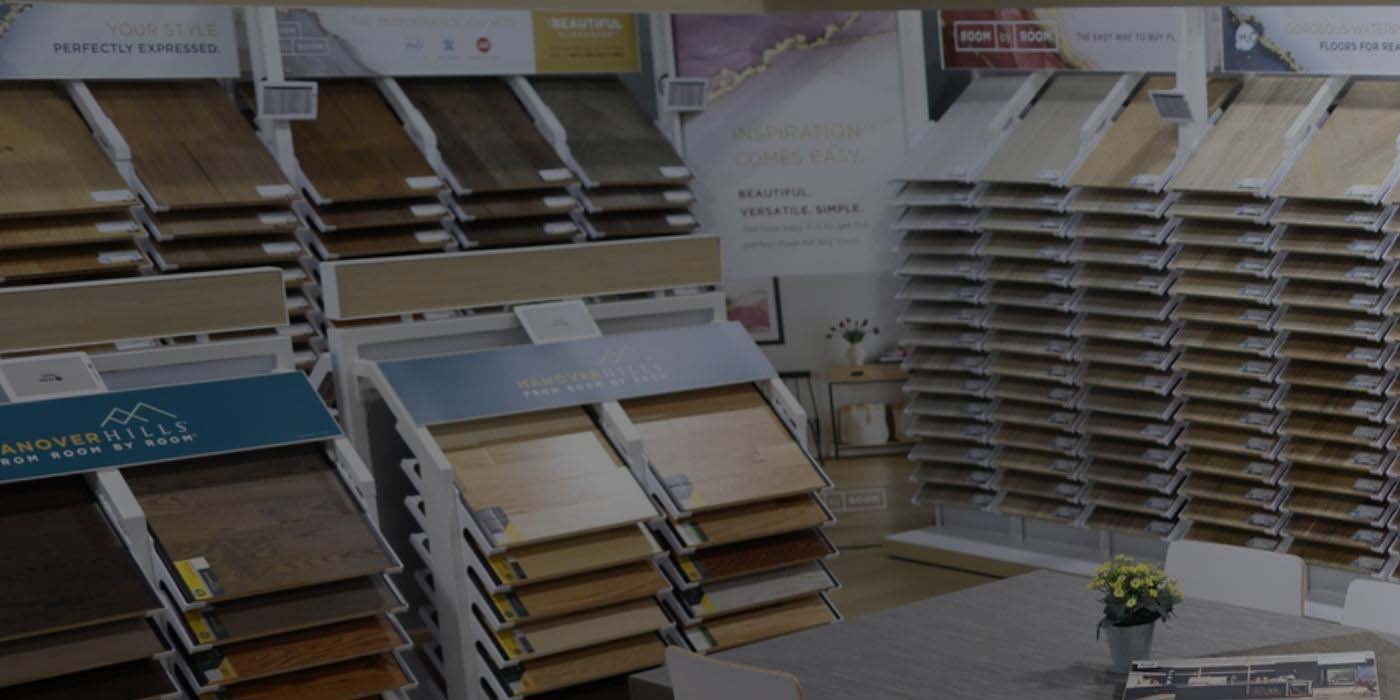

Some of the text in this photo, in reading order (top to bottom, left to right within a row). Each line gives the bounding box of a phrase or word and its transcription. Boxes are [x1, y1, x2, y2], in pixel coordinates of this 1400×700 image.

[961, 31, 992, 42] ROOM
[1021, 31, 1052, 42] ROOM
[53, 42, 134, 55] PERFECTLY
[1319, 41, 1356, 51] FLOORS
[1360, 41, 1378, 51] FOR
[815, 203, 864, 214] SIMPLE.
[104, 420, 189, 443] HILLS
[51, 446, 103, 460] ROOM
[112, 440, 135, 452] BY
[144, 433, 194, 448] ROOM
